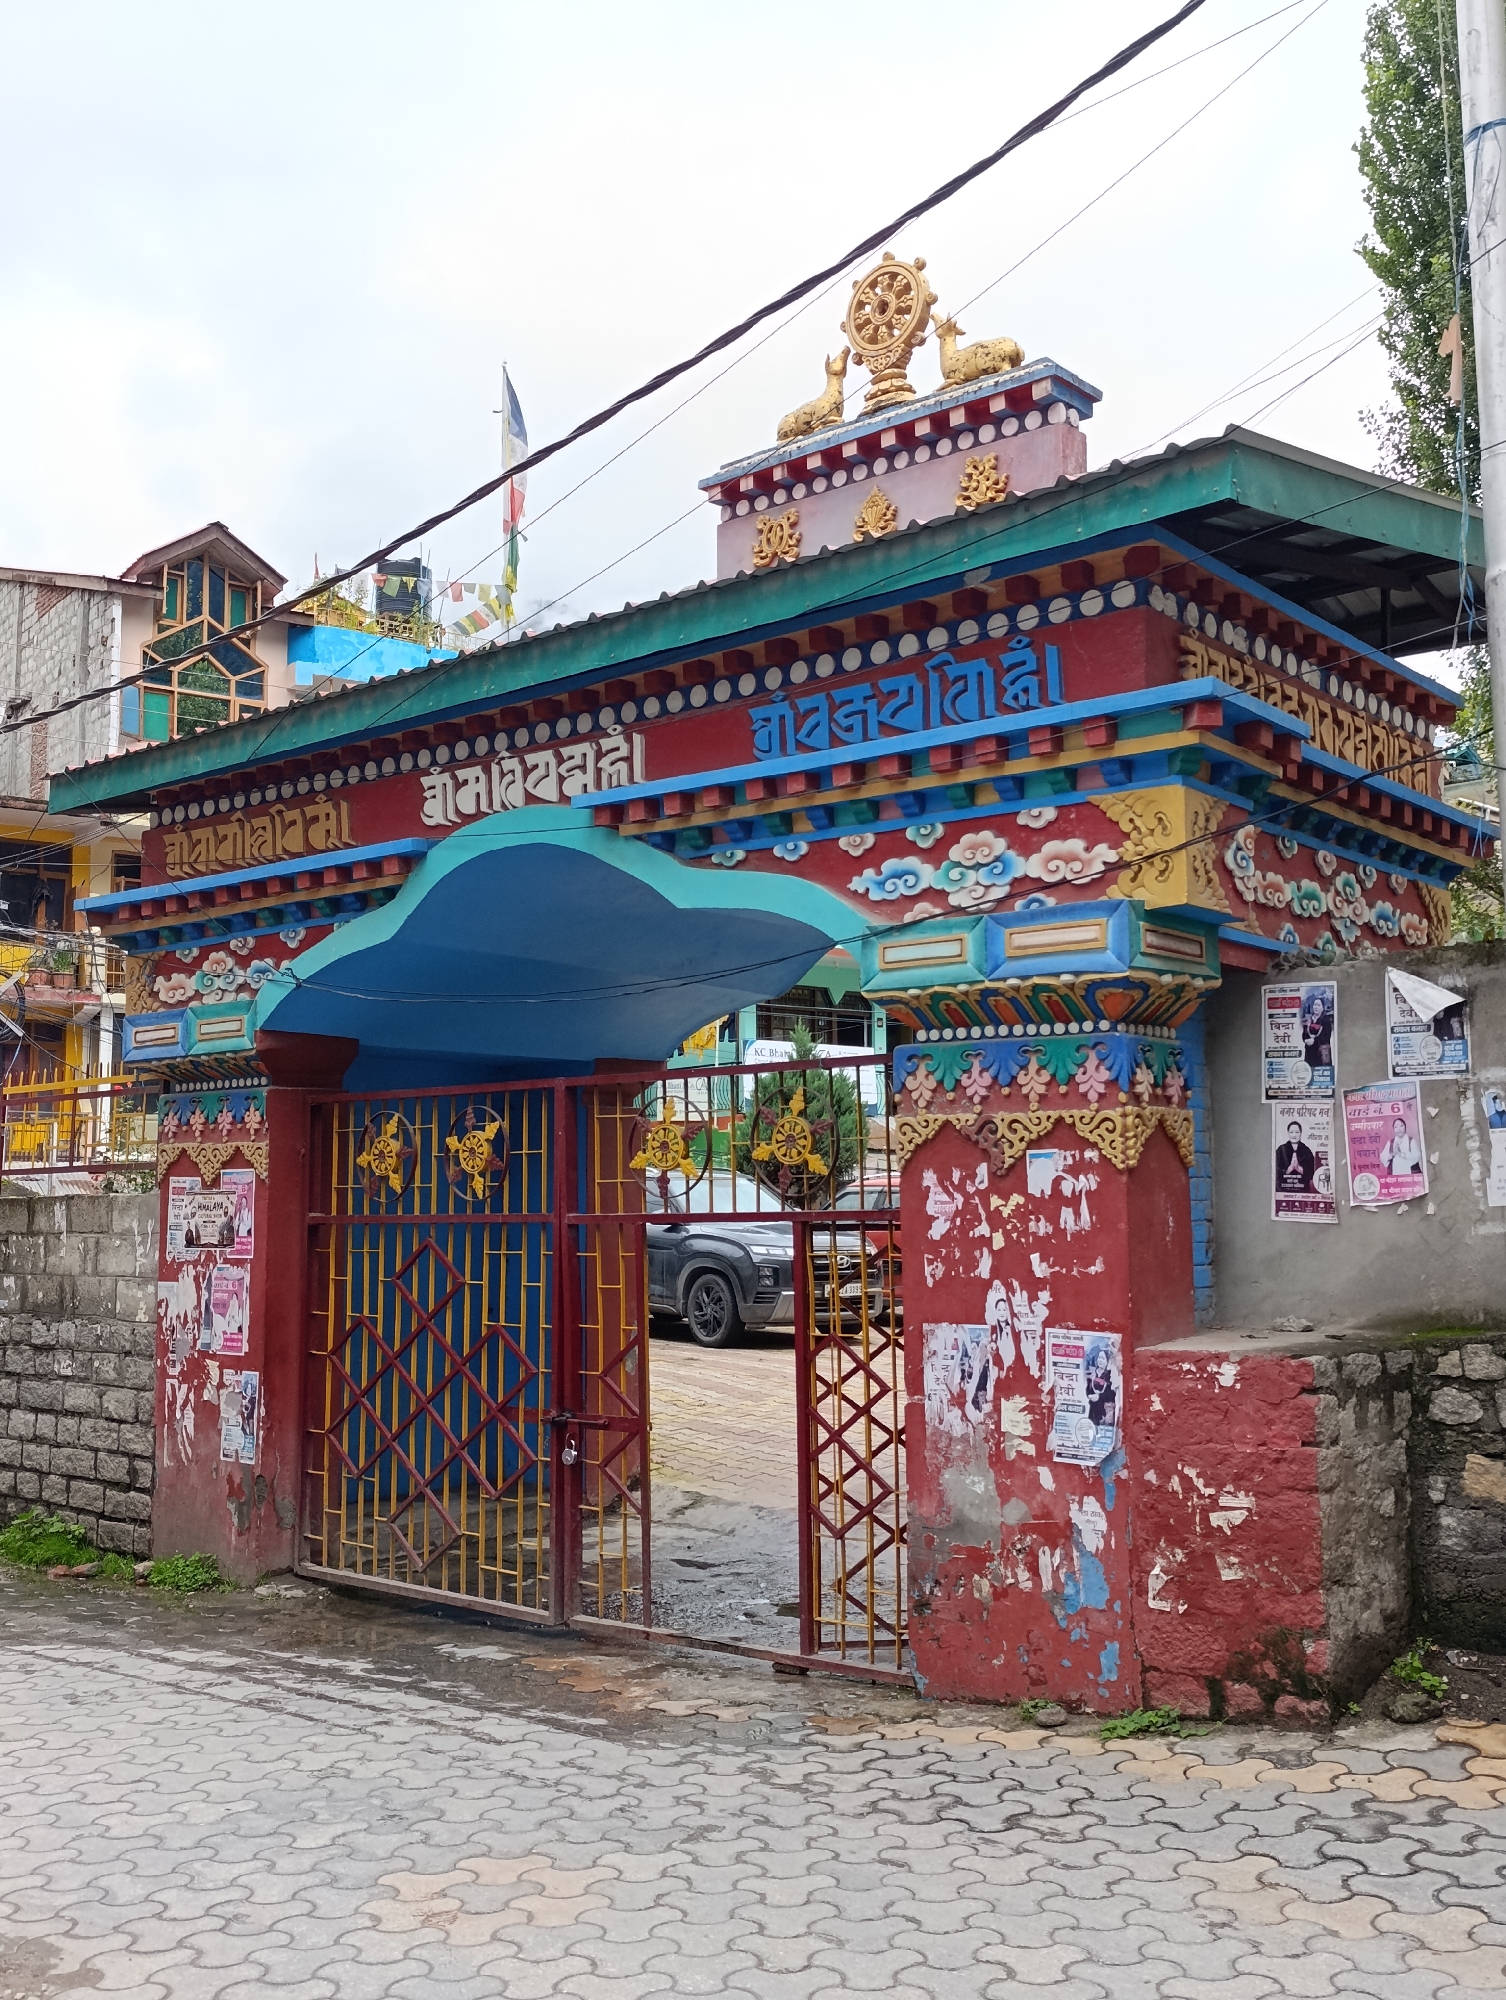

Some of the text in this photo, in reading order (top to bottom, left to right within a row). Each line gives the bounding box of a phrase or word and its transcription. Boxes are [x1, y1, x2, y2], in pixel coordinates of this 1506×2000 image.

[1272, 1032, 1291, 1044] देवी
[1279, 1107, 1296, 1118] नगर
[1390, 1102, 1401, 1114] 6
[1367, 1132, 1381, 1144] देवी
[197, 1201, 224, 1212] HIMALAYA
